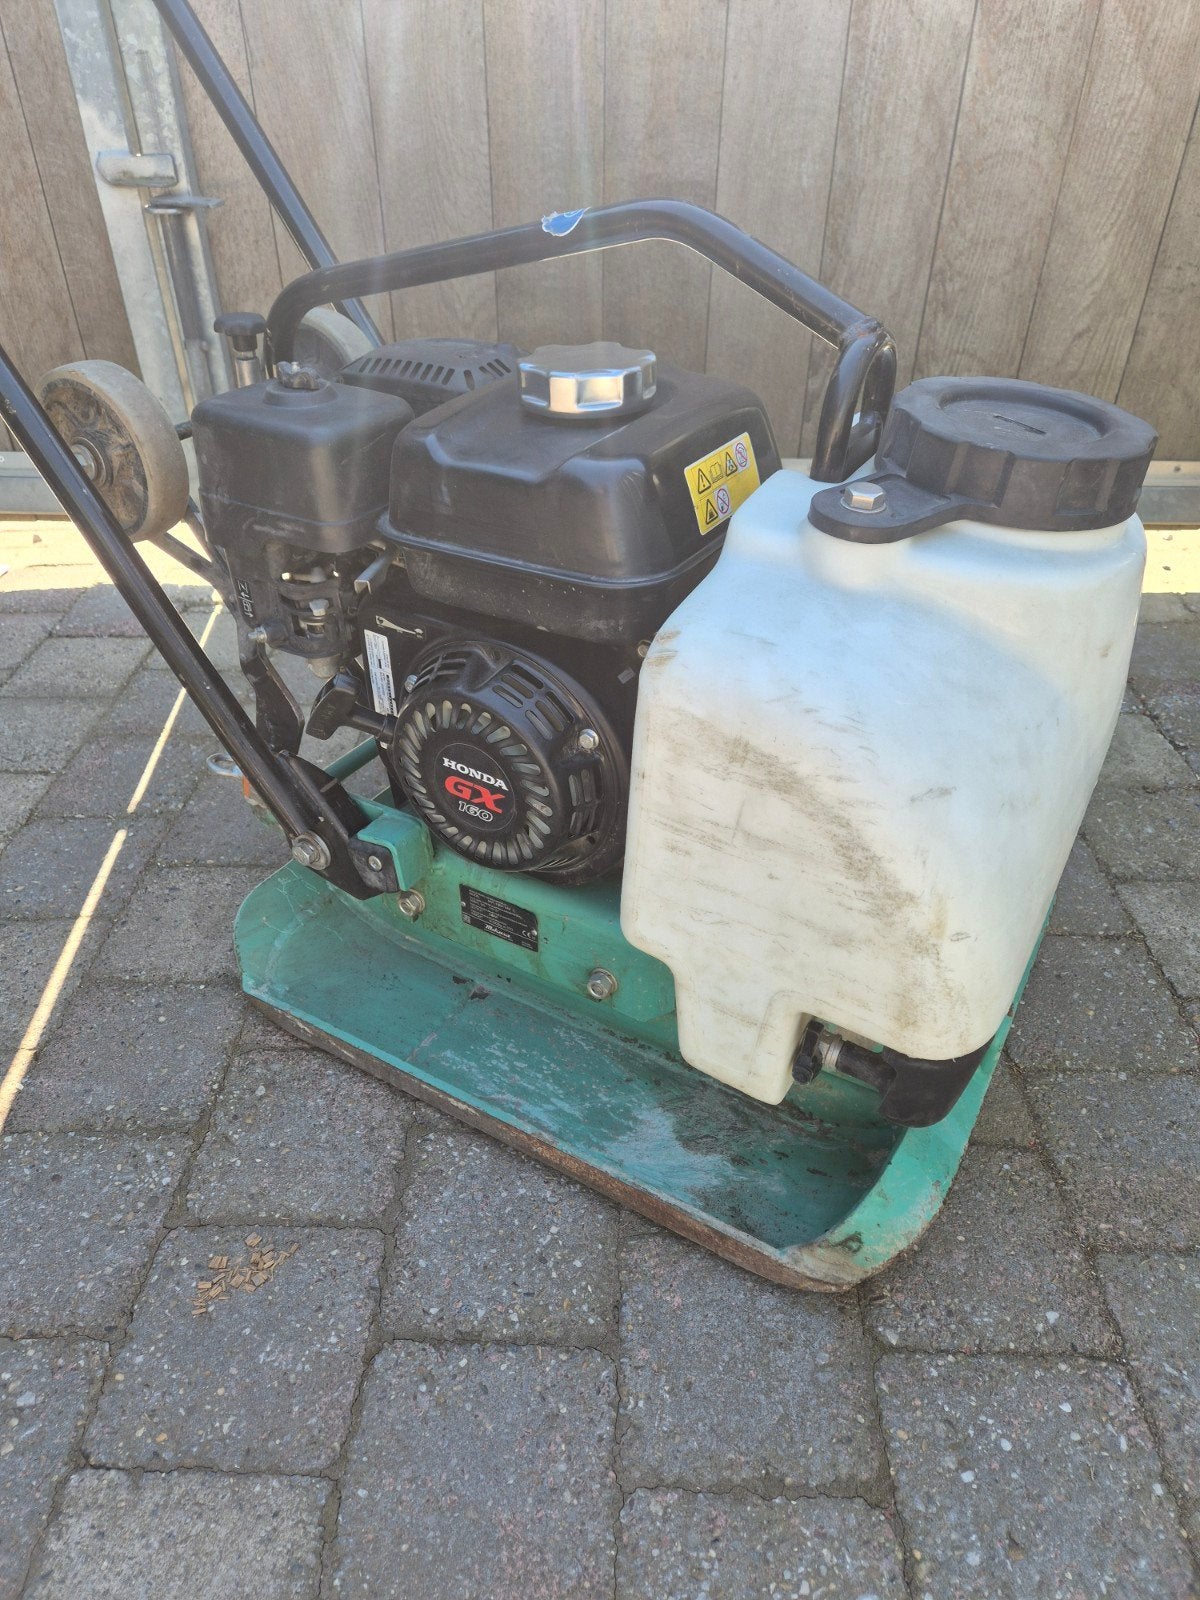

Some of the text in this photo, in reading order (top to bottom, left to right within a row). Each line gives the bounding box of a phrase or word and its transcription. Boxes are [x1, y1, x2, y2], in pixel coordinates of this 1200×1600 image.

[442, 757, 509, 791] HONDA
[444, 775, 506, 814] GX
[458, 800, 494, 822] 160
